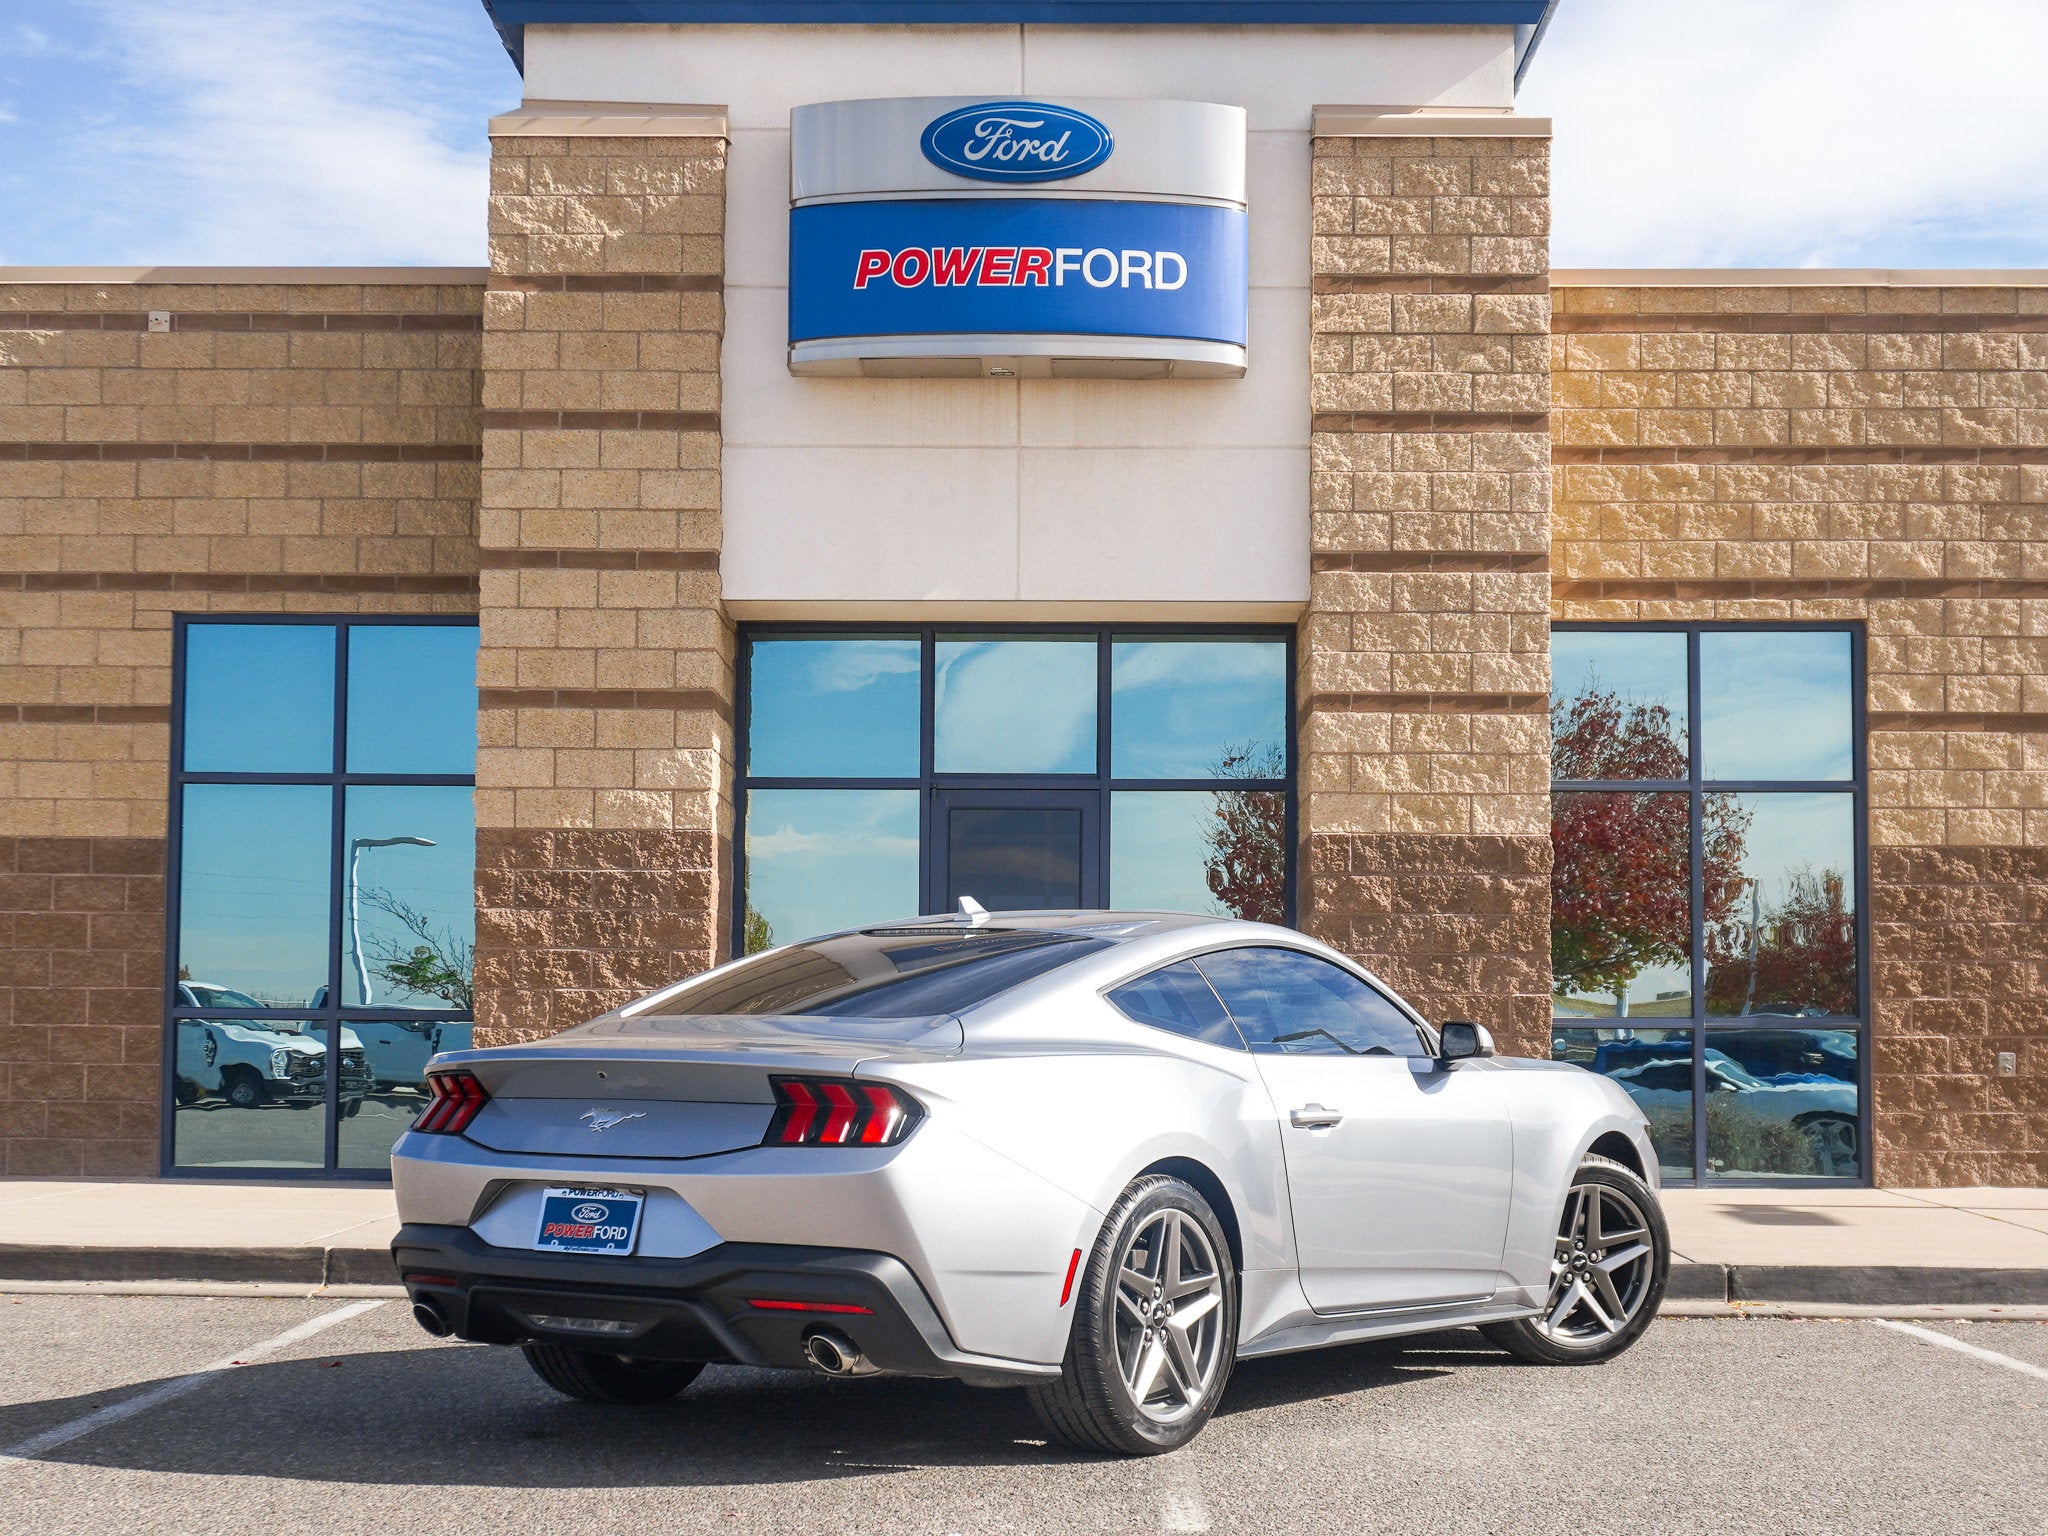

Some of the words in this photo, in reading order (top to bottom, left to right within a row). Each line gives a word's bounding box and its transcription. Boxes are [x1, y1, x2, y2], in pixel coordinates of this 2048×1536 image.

[963, 117, 1071, 162] Ford
[853, 246, 1188, 290] POWERFORD
[578, 1205, 602, 1219] Ford
[544, 1222, 628, 1240] POWERFORD
